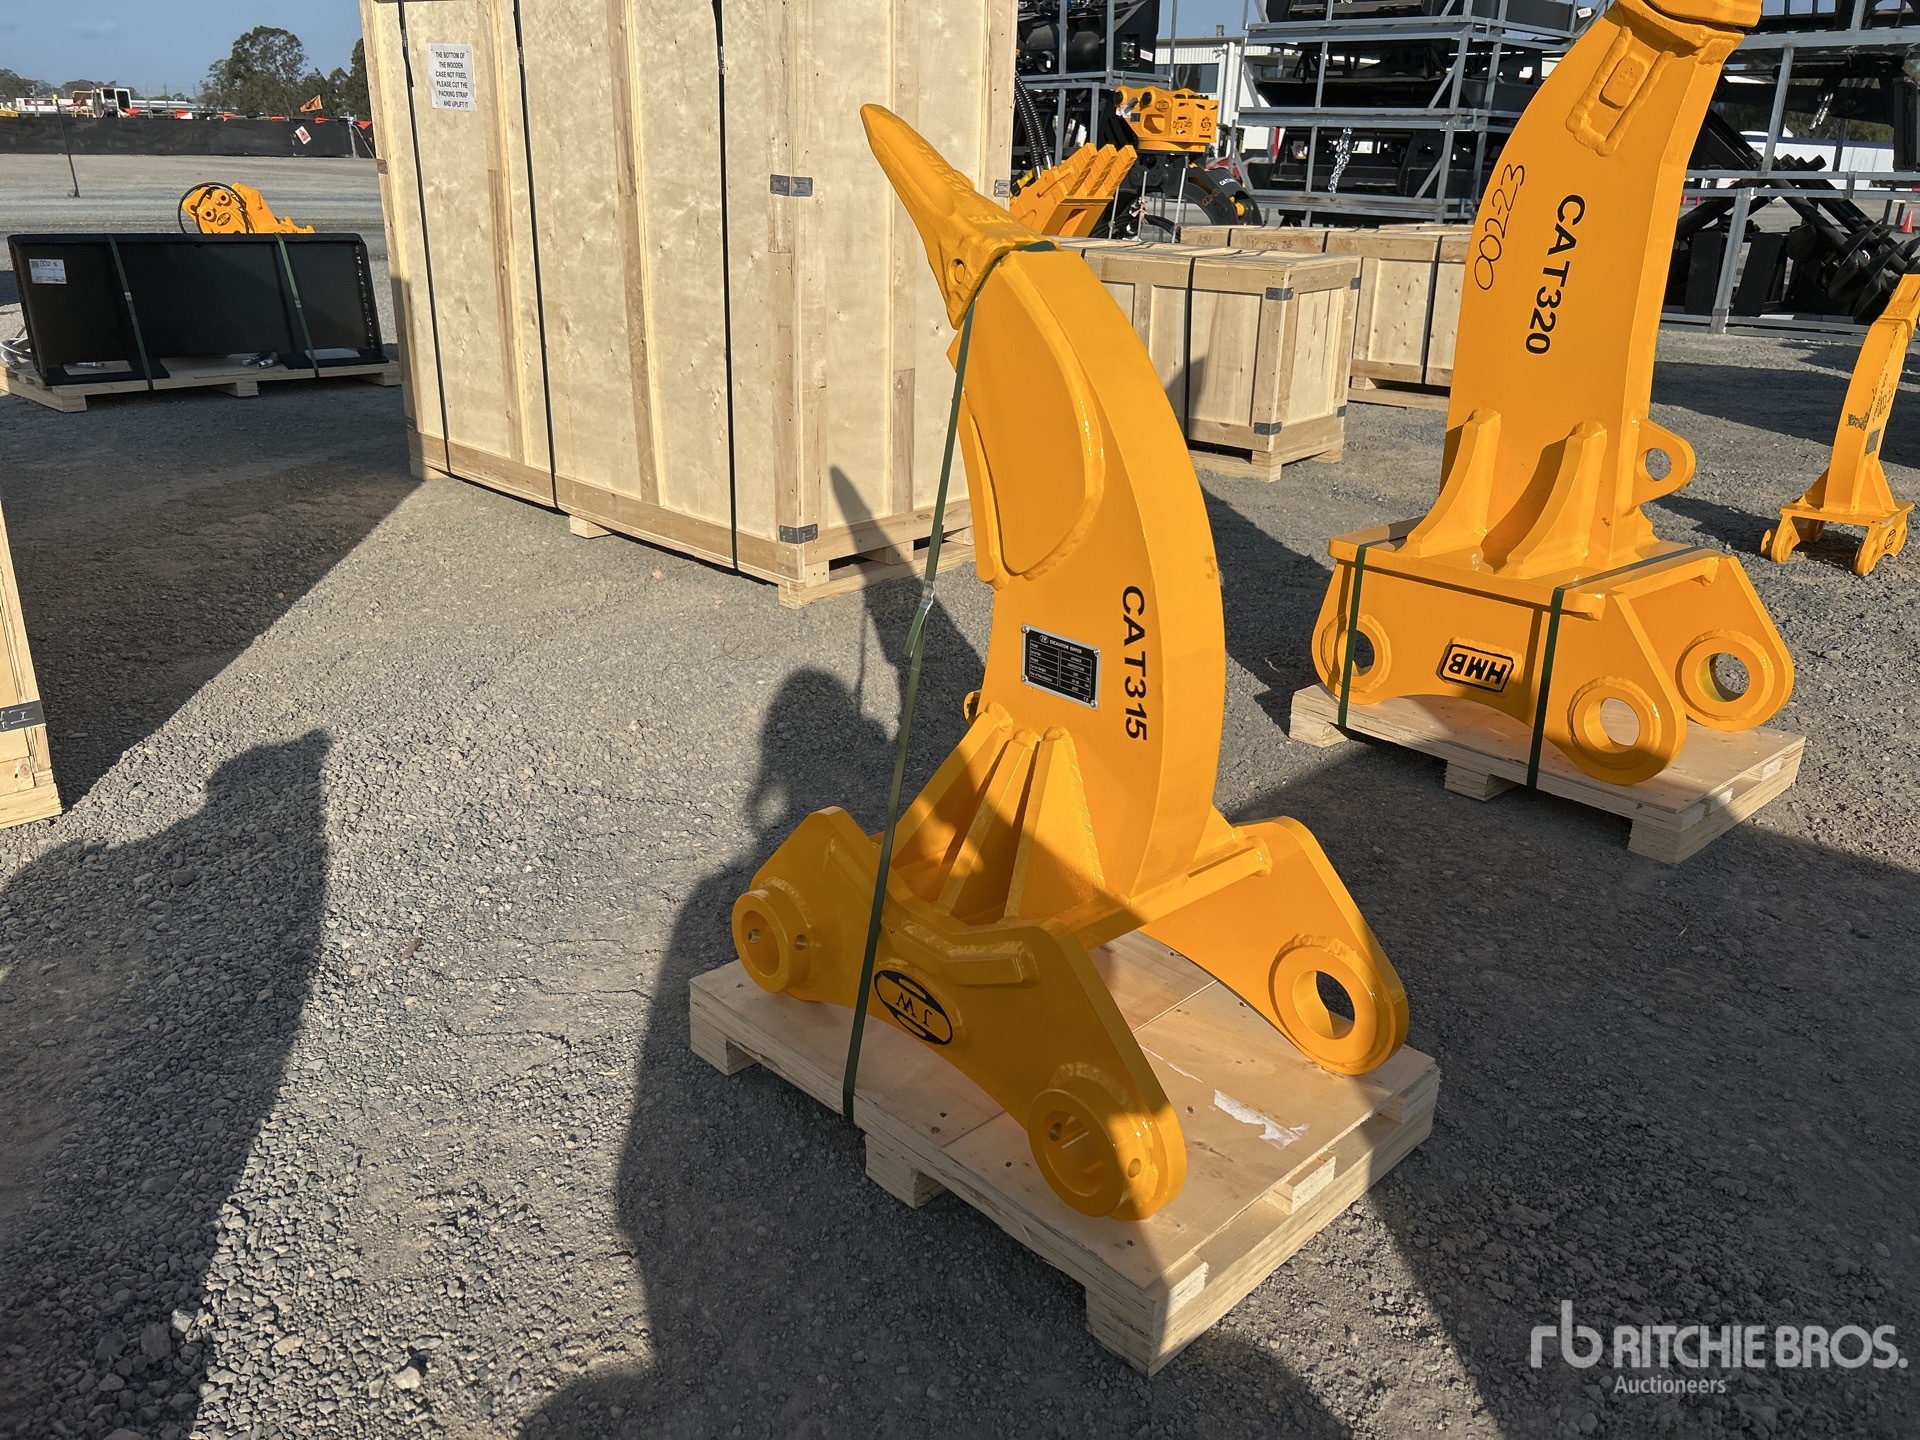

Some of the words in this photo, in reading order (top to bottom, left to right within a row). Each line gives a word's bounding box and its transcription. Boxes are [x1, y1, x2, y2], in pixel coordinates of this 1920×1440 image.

[455, 72, 467, 80] FIXED,
[1525, 194, 1586, 355] CAT320
[1122, 585, 1148, 741] CAT315
[1448, 652, 1508, 685] HMB
[895, 992, 932, 1027] JW
